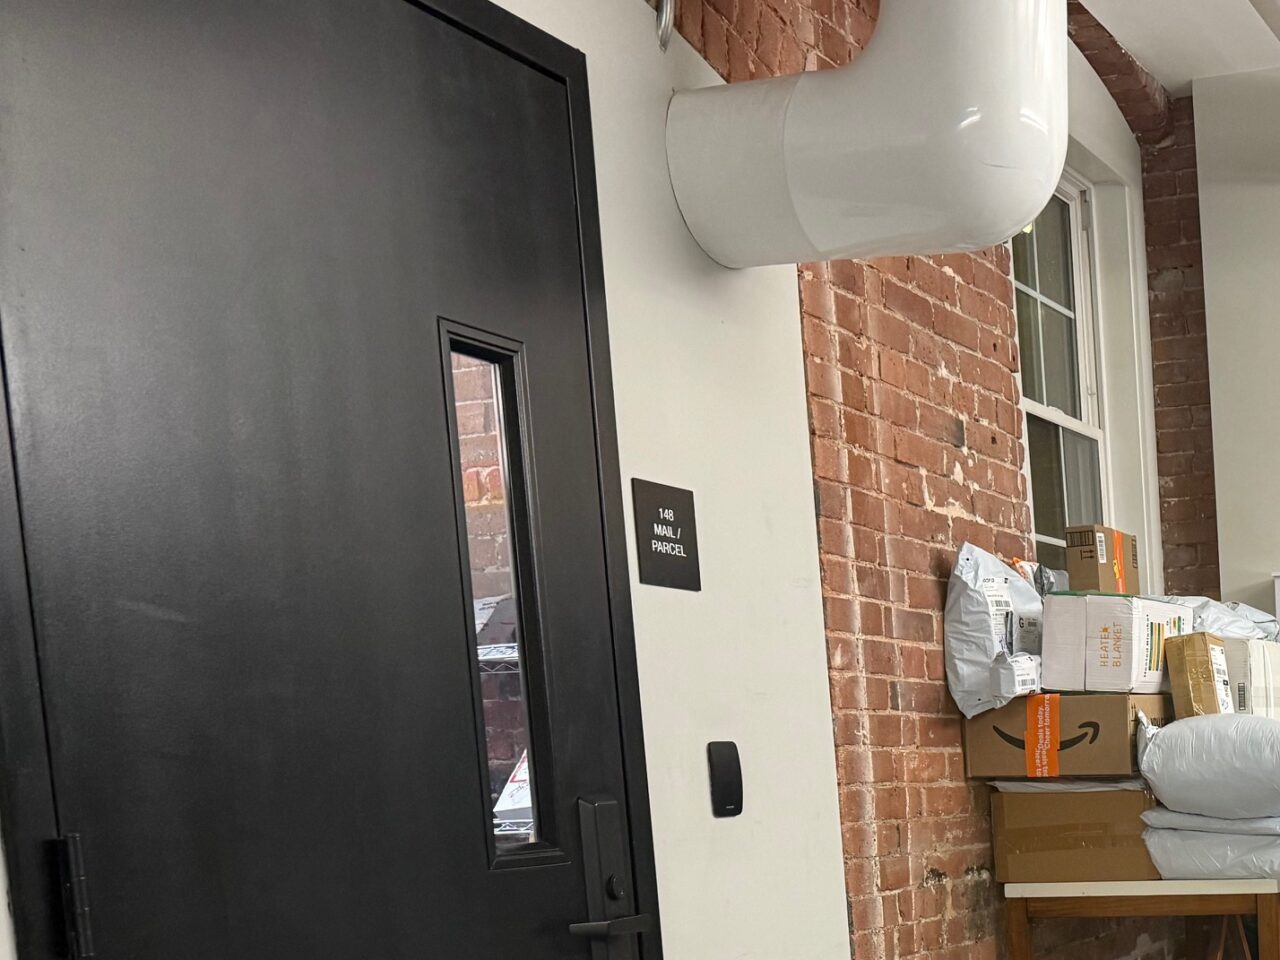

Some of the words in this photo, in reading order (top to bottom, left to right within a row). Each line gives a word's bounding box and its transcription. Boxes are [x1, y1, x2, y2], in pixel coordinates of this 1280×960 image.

[658, 508, 674, 521] 148
[653, 523, 676, 538] MAIL
[651, 540, 687, 557] PARCEL
[1112, 622, 1122, 667] BLANKET
[1036, 728, 1045, 749] Deals
[1043, 728, 1051, 749] Cheer
